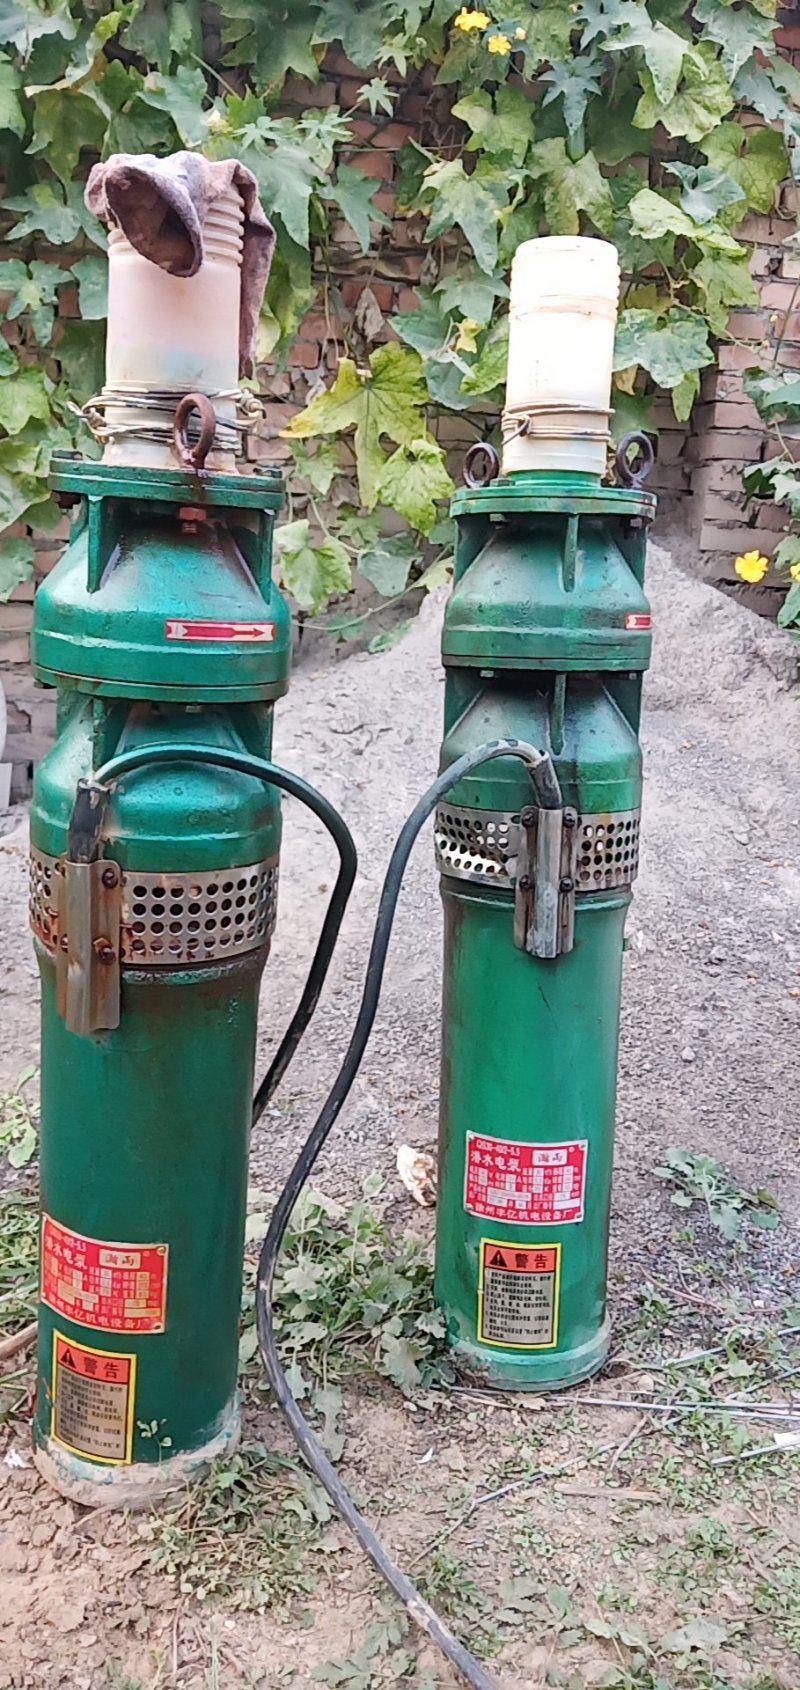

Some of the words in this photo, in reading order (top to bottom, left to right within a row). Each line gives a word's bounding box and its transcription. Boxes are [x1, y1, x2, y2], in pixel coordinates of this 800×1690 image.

[470, 1150, 521, 1172] 潜水电泵
[515, 1253, 548, 1269] 警告
[83, 1356, 120, 1379] 警告
